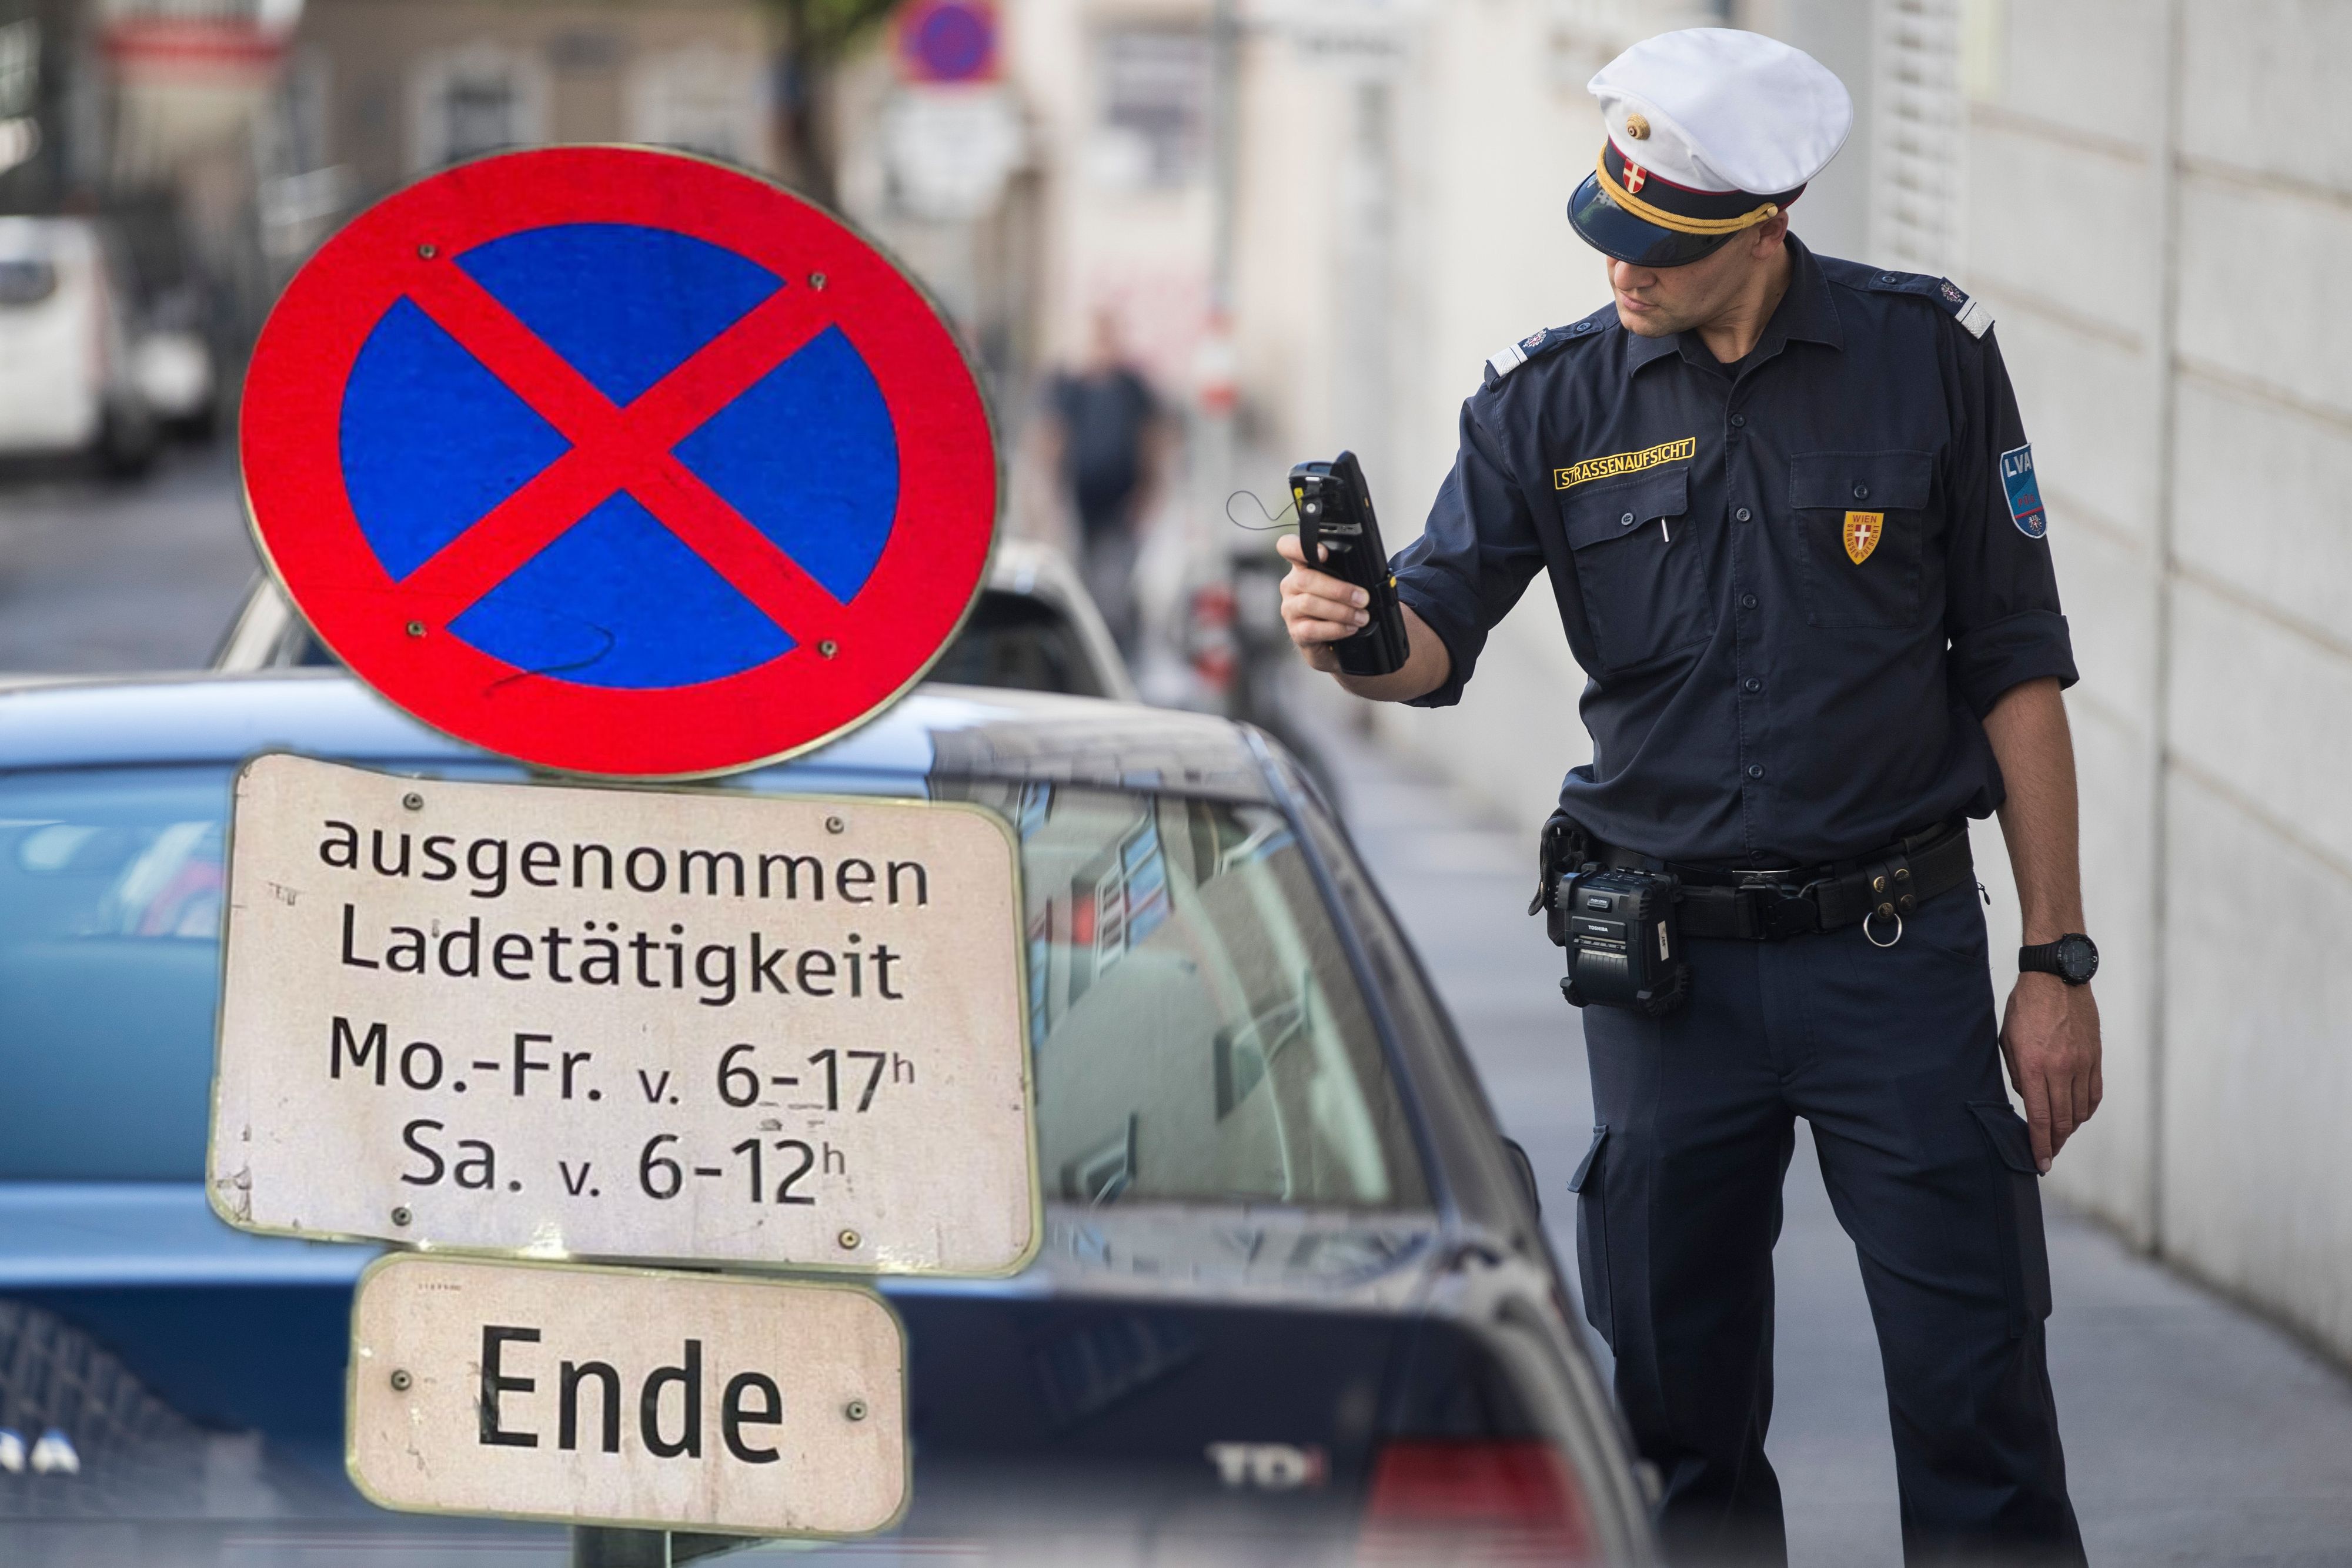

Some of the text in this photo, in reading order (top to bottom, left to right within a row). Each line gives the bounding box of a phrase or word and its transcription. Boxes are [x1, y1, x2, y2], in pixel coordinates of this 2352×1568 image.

[1562, 442, 1689, 486] STRASSENAUFSICHT
[2004, 452, 2032, 477] LVA
[1853, 515, 1877, 523] WIEN
[320, 821, 928, 905] ausgenommen
[342, 904, 904, 1006] Ladetätigkeit
[331, 1017, 601, 1101] Mo.-Fr.
[639, 1070, 679, 1105] v.
[401, 1119, 521, 1191] Sa.
[559, 1162, 600, 1197] v.
[480, 1326, 783, 1464] Ende
